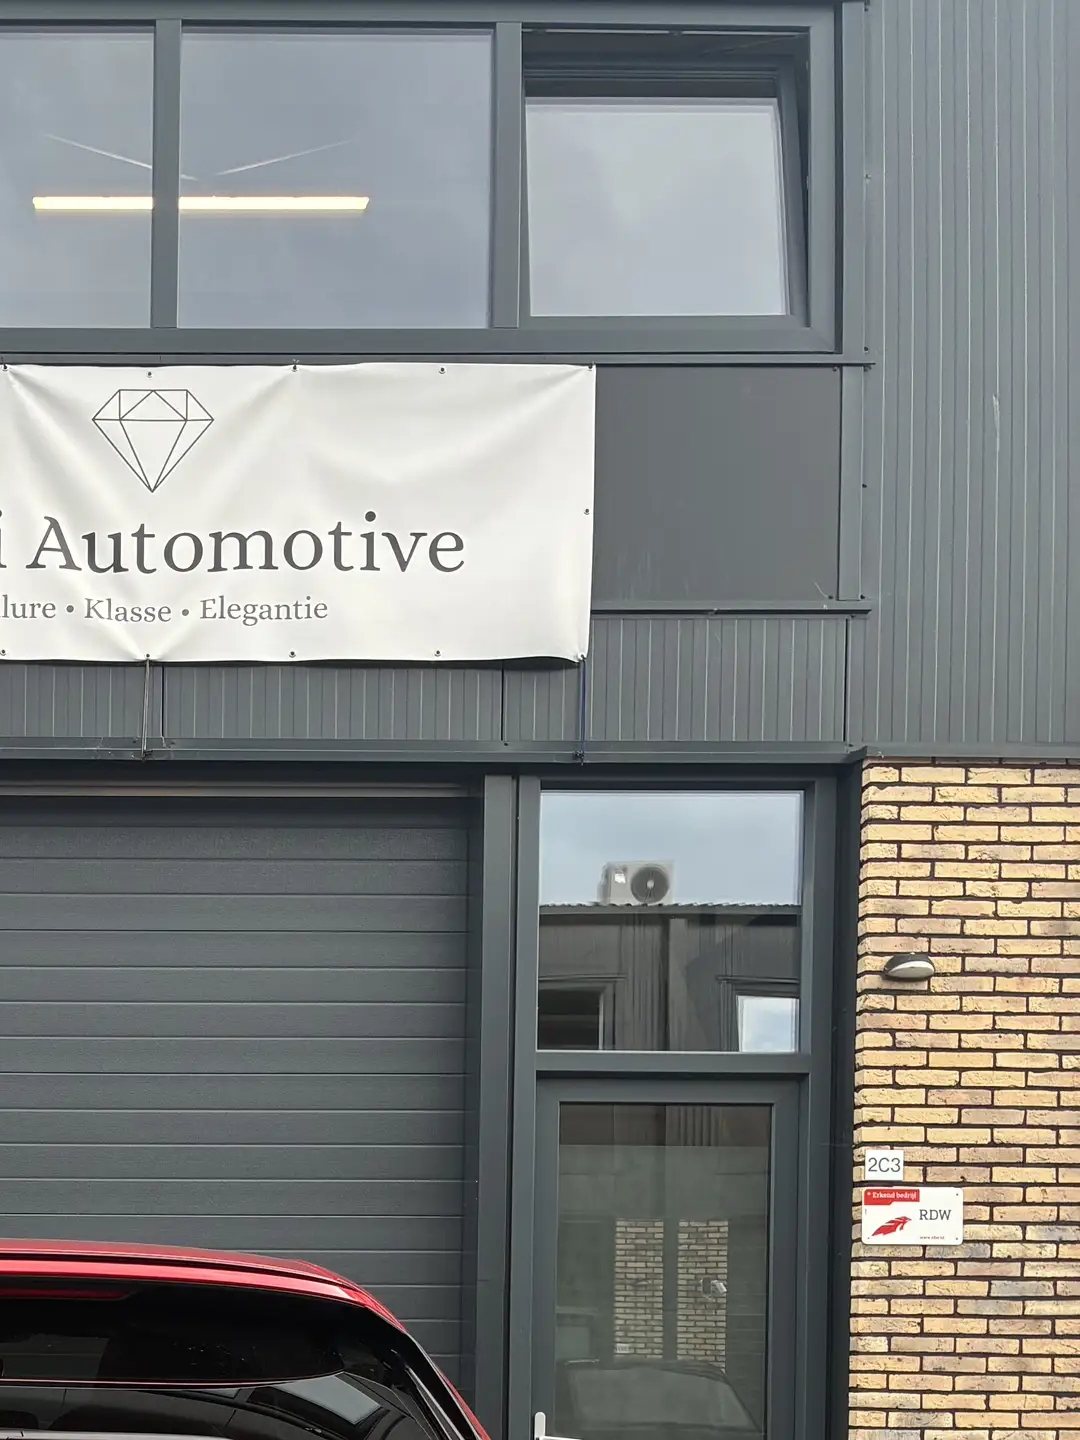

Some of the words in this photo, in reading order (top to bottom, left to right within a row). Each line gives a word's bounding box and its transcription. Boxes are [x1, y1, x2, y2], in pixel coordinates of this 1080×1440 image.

[25, 510, 465, 574] Automotive
[84, 598, 172, 623] Klasse
[200, 595, 328, 627] Elegantie
[867, 1157, 901, 1173] 2C3
[919, 1209, 951, 1221] RDW
